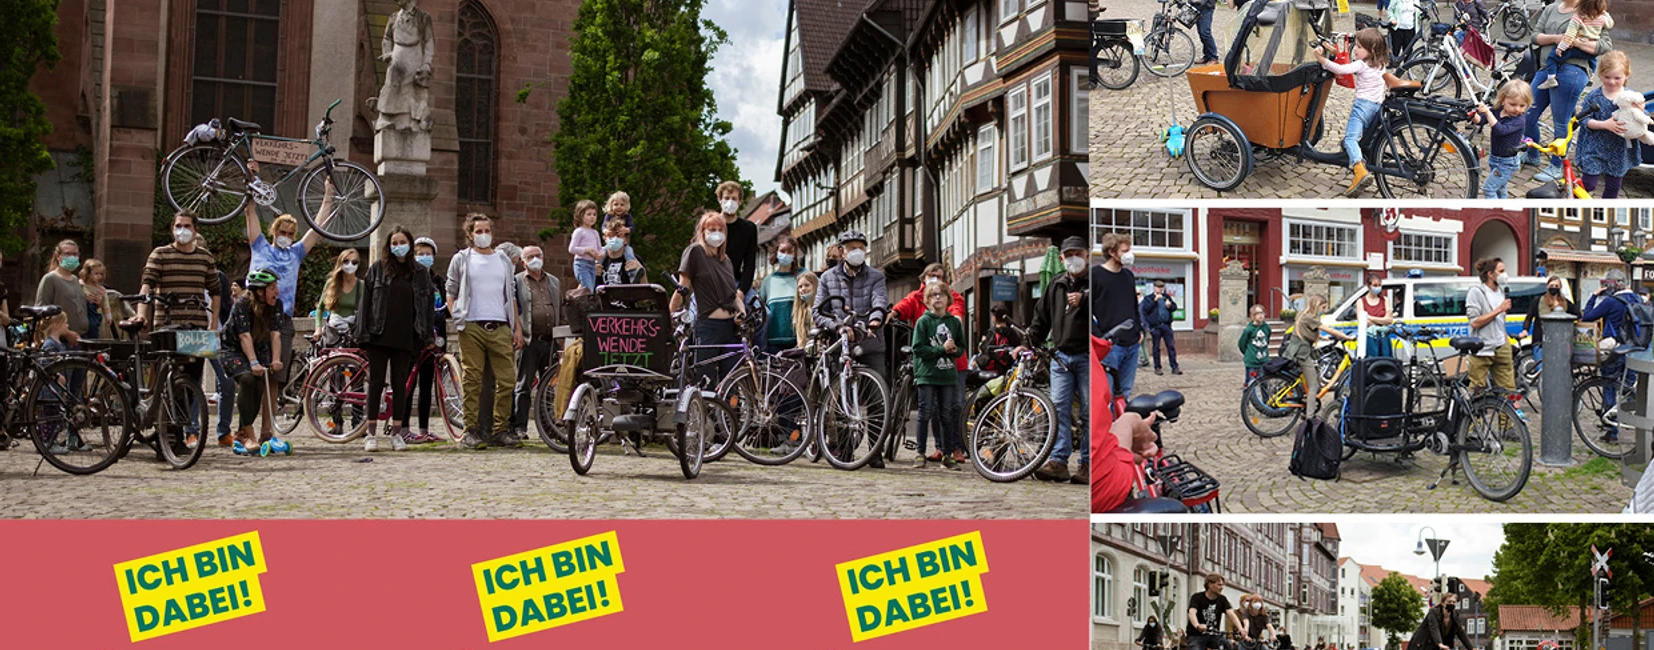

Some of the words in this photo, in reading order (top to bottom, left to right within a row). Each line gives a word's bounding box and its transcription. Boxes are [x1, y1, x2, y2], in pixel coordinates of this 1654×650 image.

[254, 148, 280, 157] WENDE
[1131, 265, 1171, 274] Apotheke
[588, 316, 661, 337] VERKEHRS-
[597, 336, 647, 353] WENDE
[598, 351, 654, 368] JETZT
